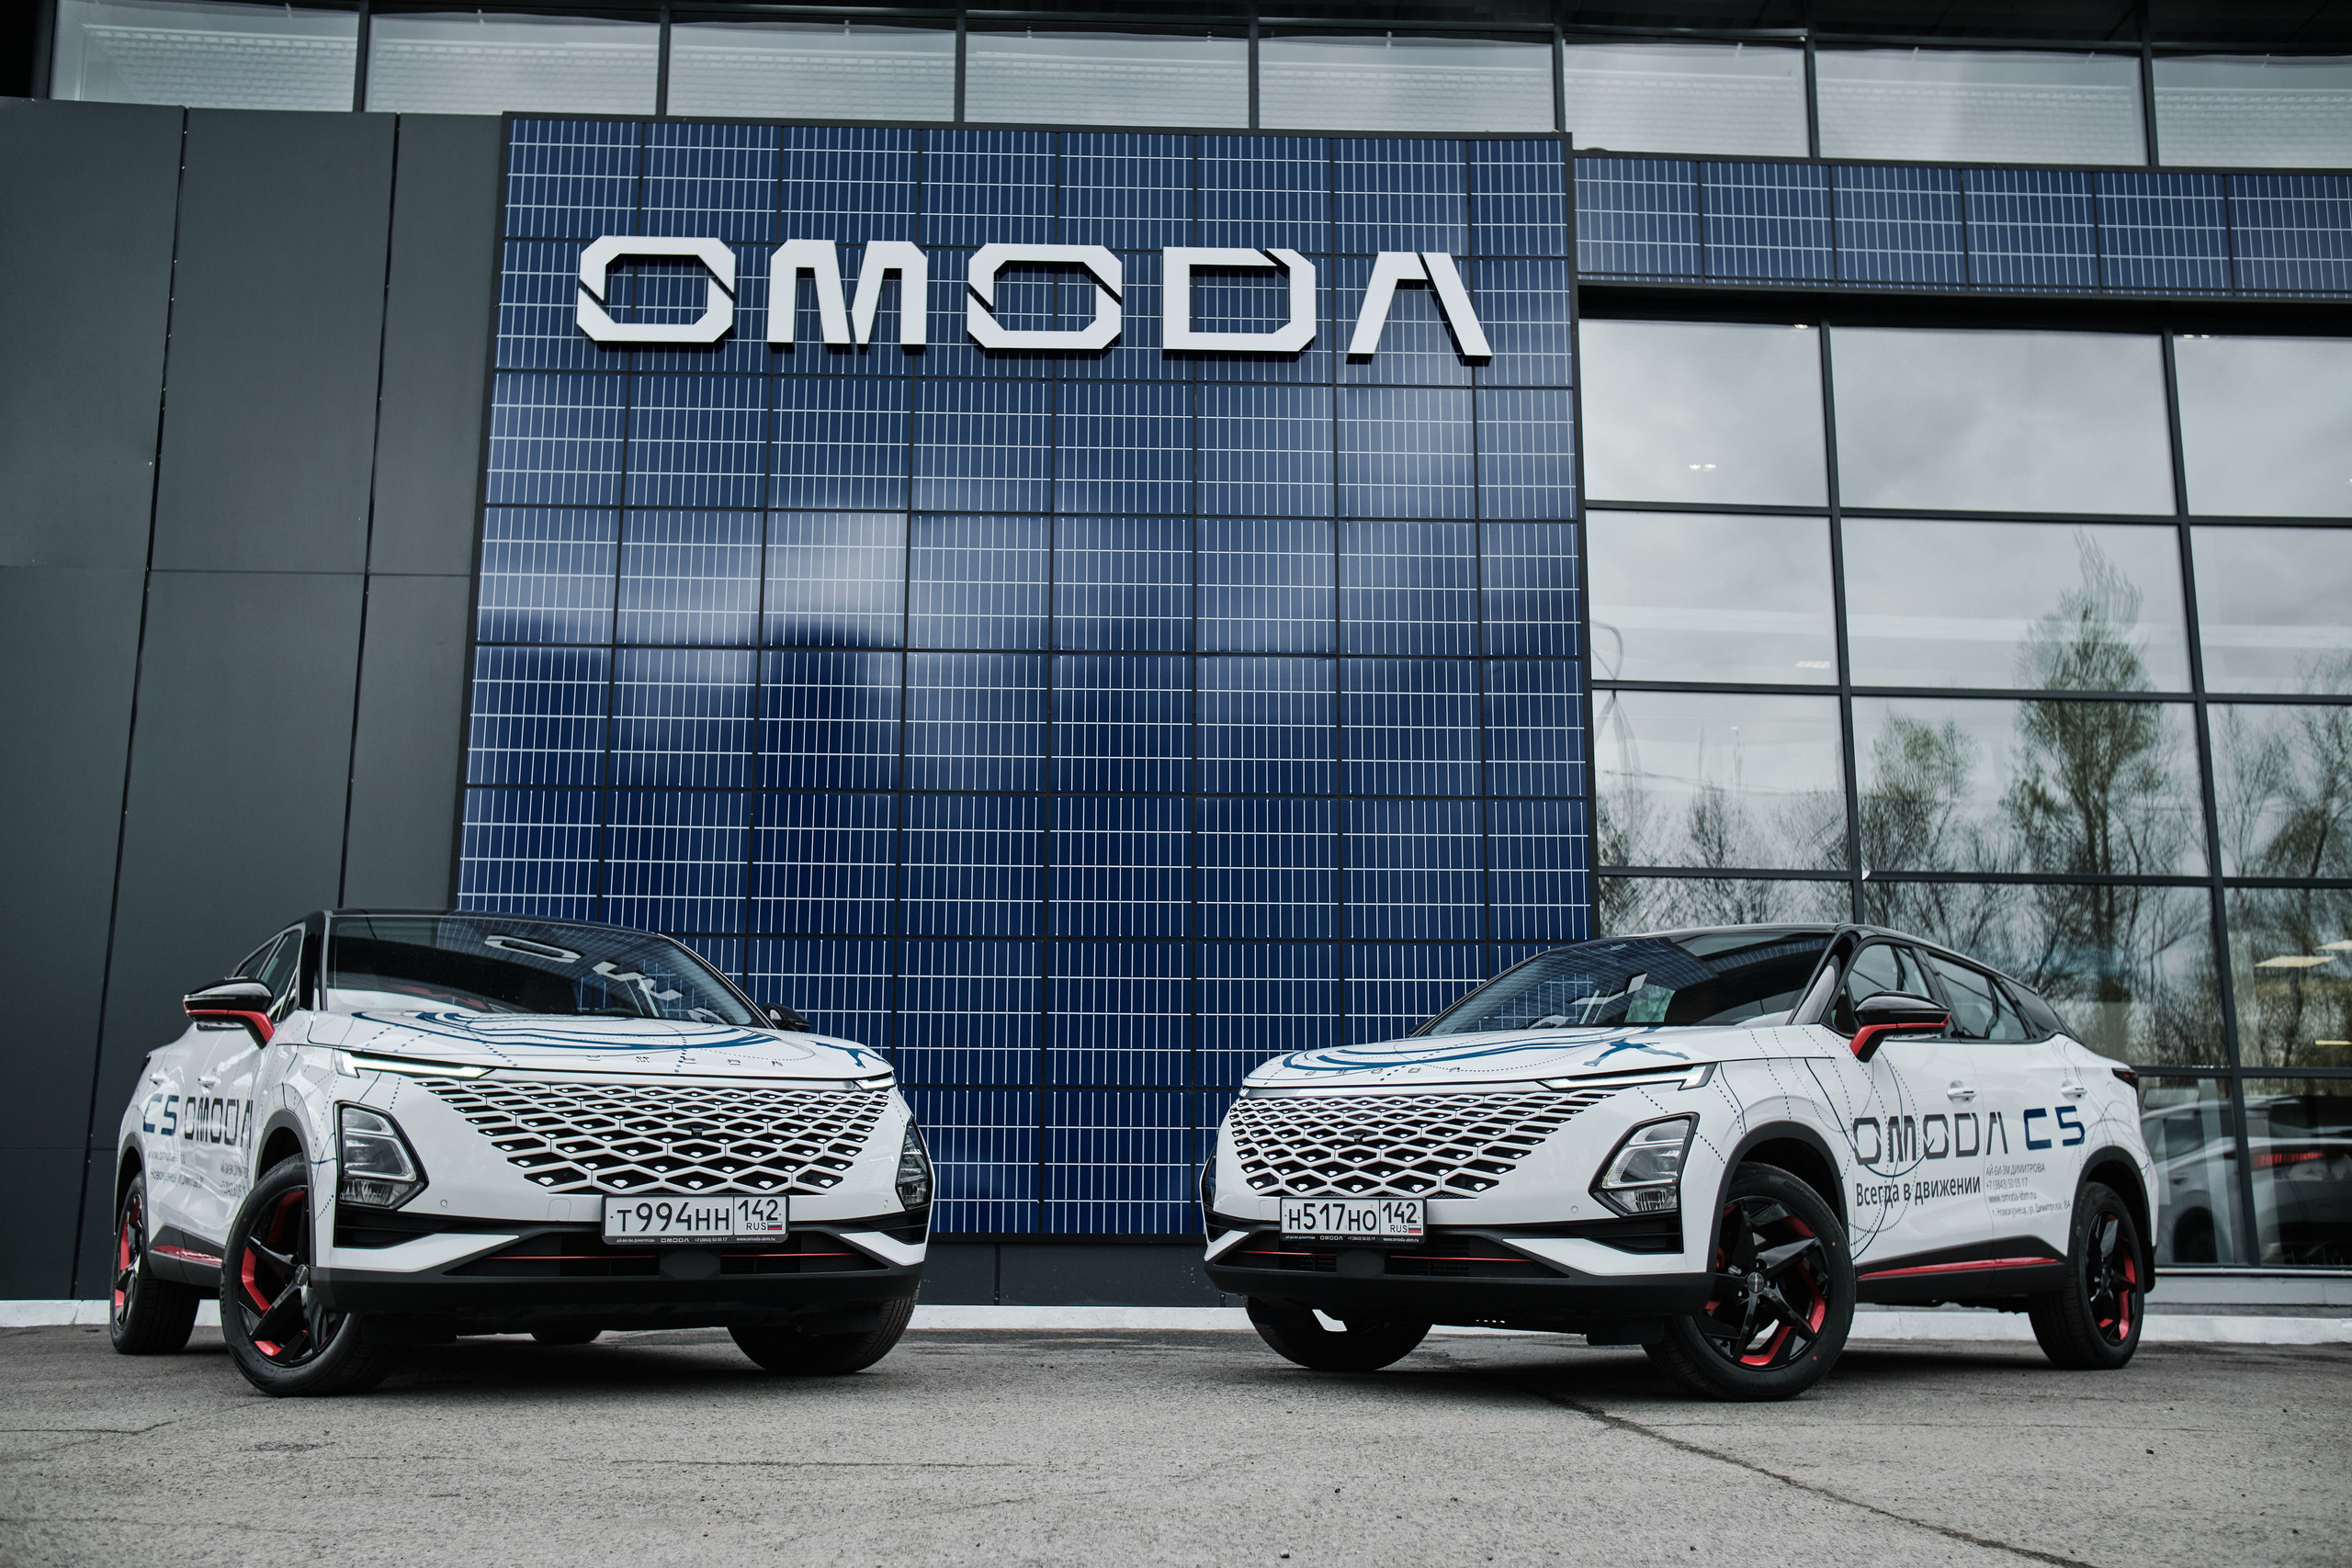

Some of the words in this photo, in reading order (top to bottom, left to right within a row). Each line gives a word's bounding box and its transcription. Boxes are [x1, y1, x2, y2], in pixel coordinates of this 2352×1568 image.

[576, 235, 1493, 362] OMODA
[185, 1097, 253, 1148] OMODA
[1853, 1111, 2008, 1166] OMODA
[2023, 1105, 2086, 1150] C5
[2011, 1162, 2046, 1175] ДИМИТРОВА
[1856, 1181, 1901, 1209] Всегда
[1904, 1187, 1911, 1201] в
[1915, 1177, 1981, 1206] движении
[738, 1199, 778, 1221] 142
[1382, 1201, 1417, 1224] 142
[746, 1223, 767, 1231] RUS
[1390, 1224, 1408, 1233] RUS
